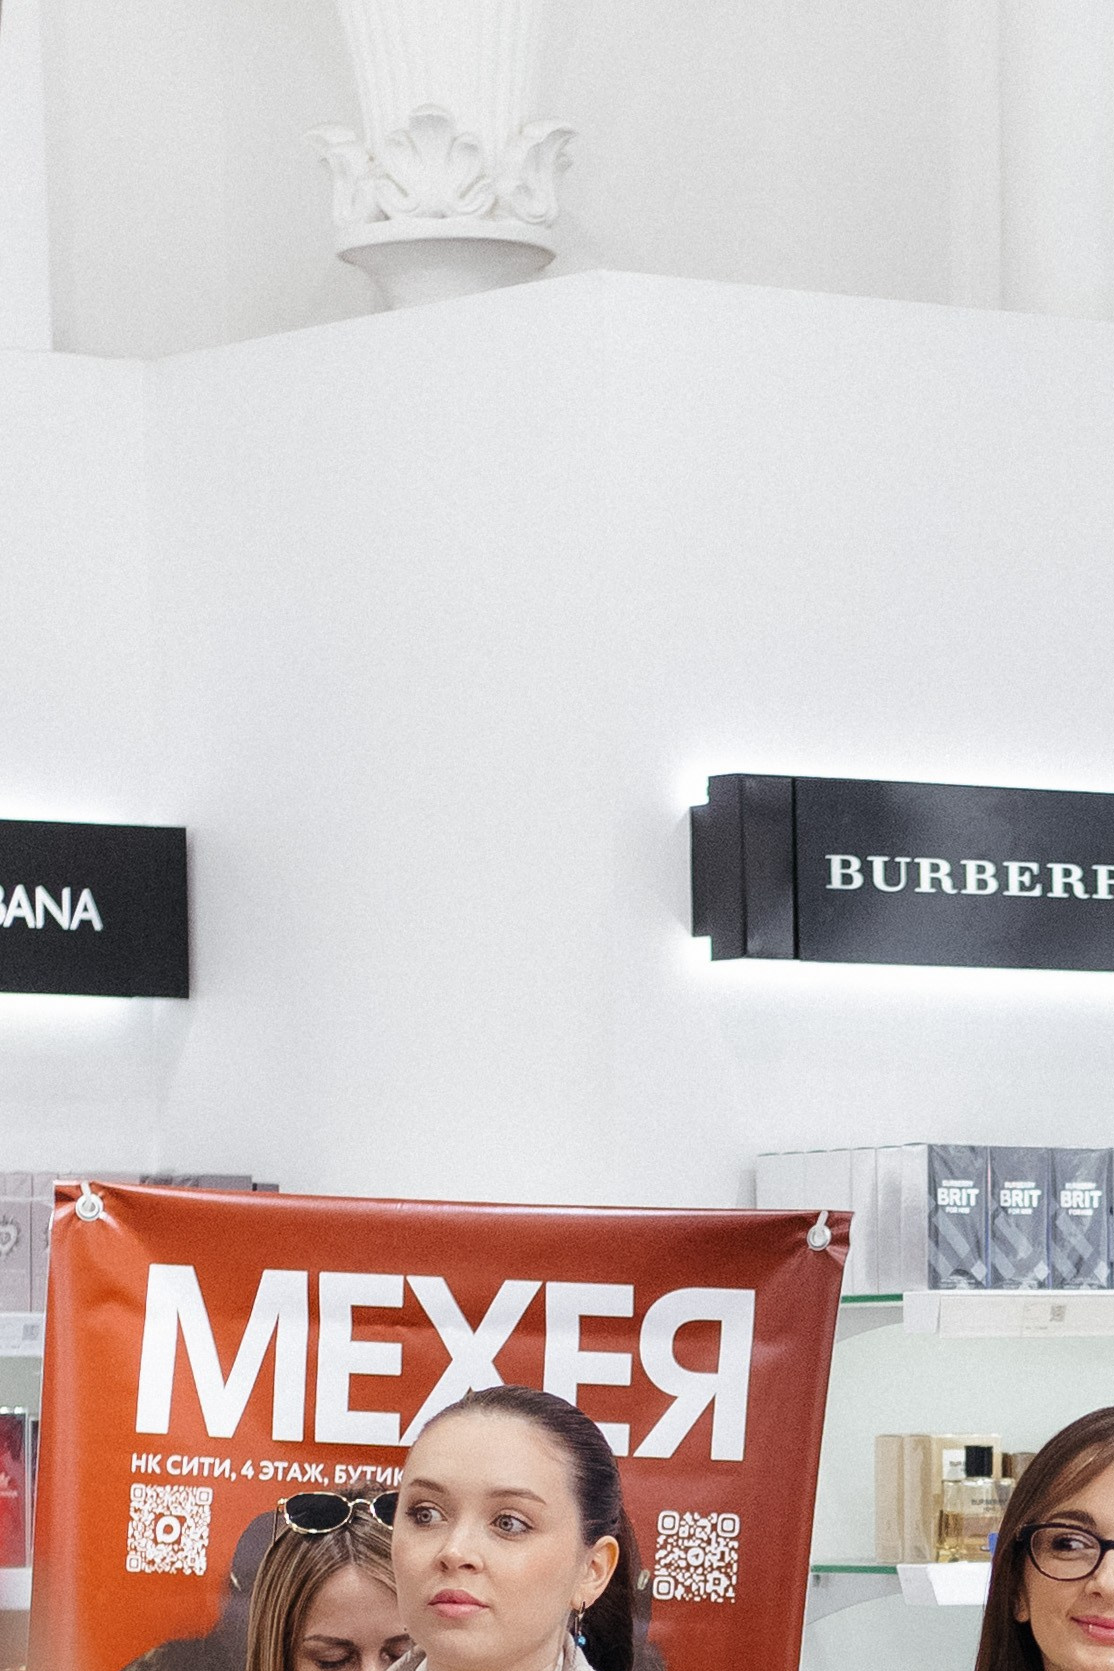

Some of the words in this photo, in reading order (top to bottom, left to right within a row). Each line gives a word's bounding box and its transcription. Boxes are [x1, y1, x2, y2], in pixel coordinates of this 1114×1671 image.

[937, 1187, 980, 1207] BRIT
[999, 1189, 1042, 1208] BRIT
[1060, 1189, 1103, 1209] BRIT
[134, 1262, 757, 1462] МЕХЕЯ
[130, 1452, 162, 1475] НК
[165, 1454, 237, 1482] СИТИ,
[240, 1460, 256, 1480] 4
[258, 1460, 329, 1487] ЭТАЖ,
